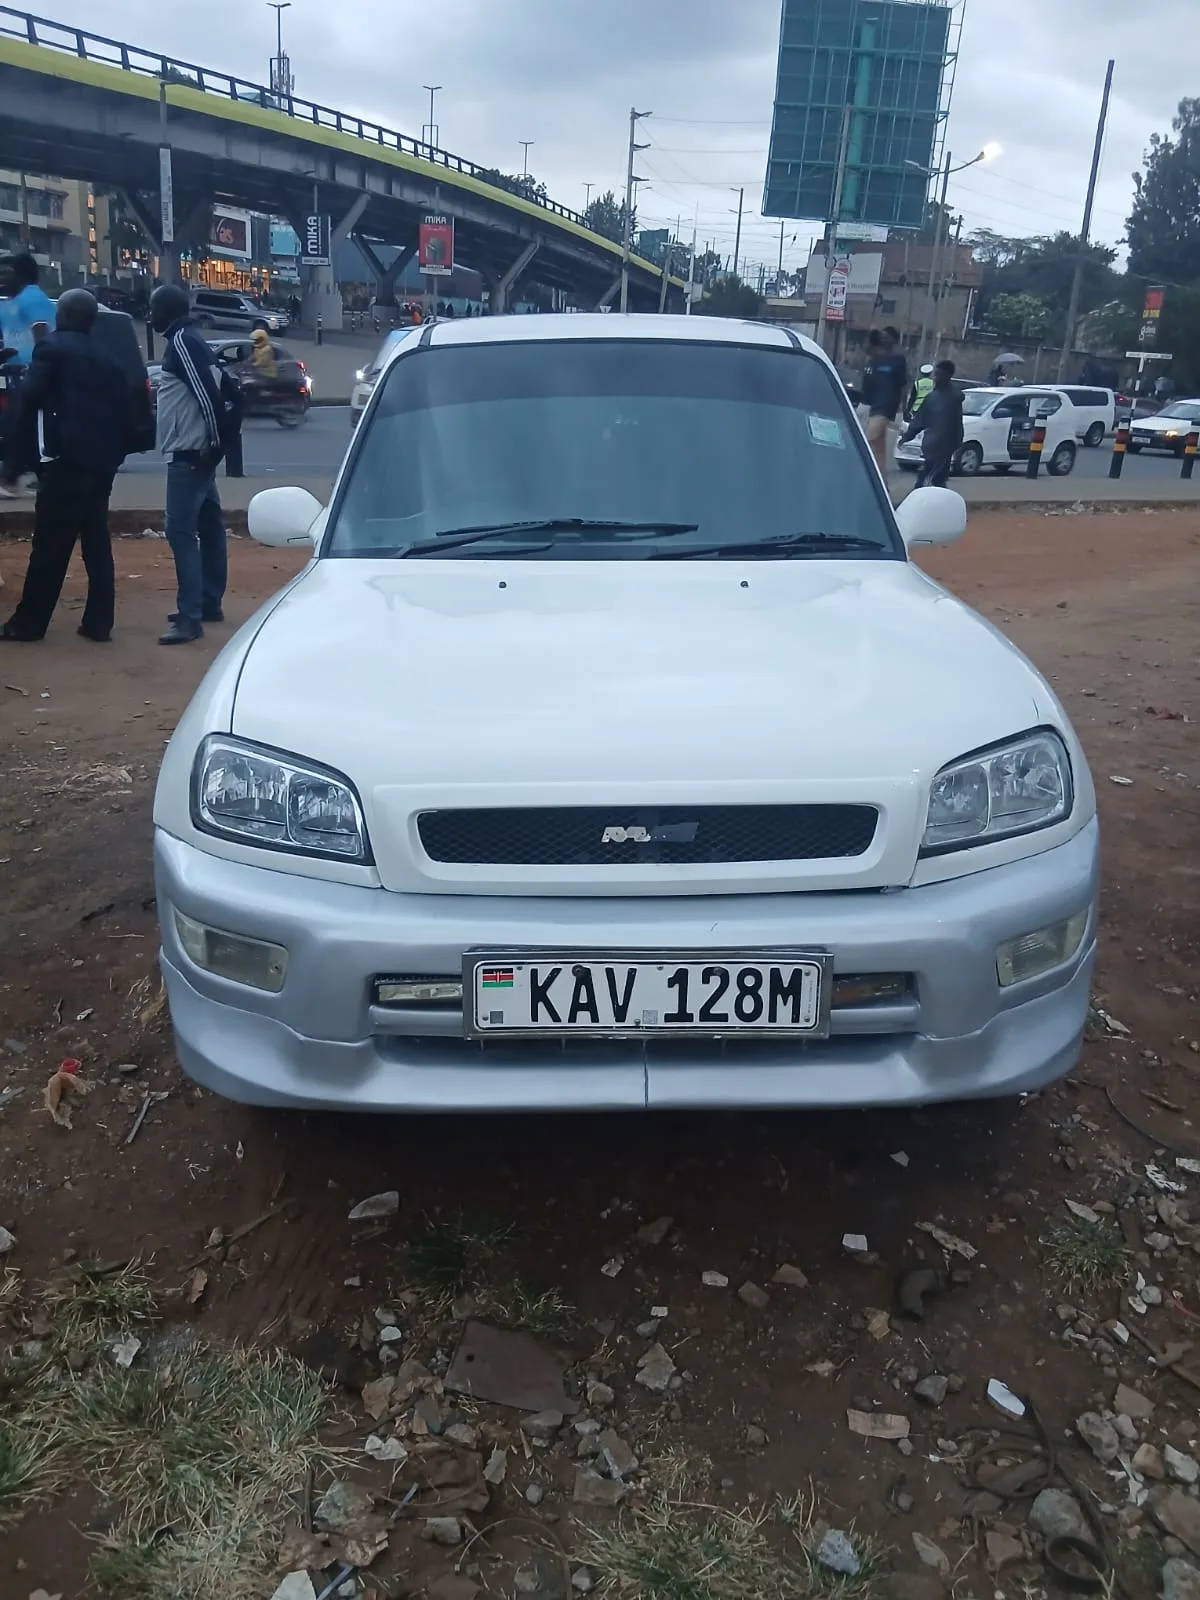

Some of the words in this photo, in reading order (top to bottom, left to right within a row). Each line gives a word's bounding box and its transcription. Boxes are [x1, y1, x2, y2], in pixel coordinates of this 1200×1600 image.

[307, 216, 318, 255] MIKA
[424, 215, 447, 224] MIKA
[530, 967, 637, 1023] KAV
[664, 967, 803, 1023] 128M
